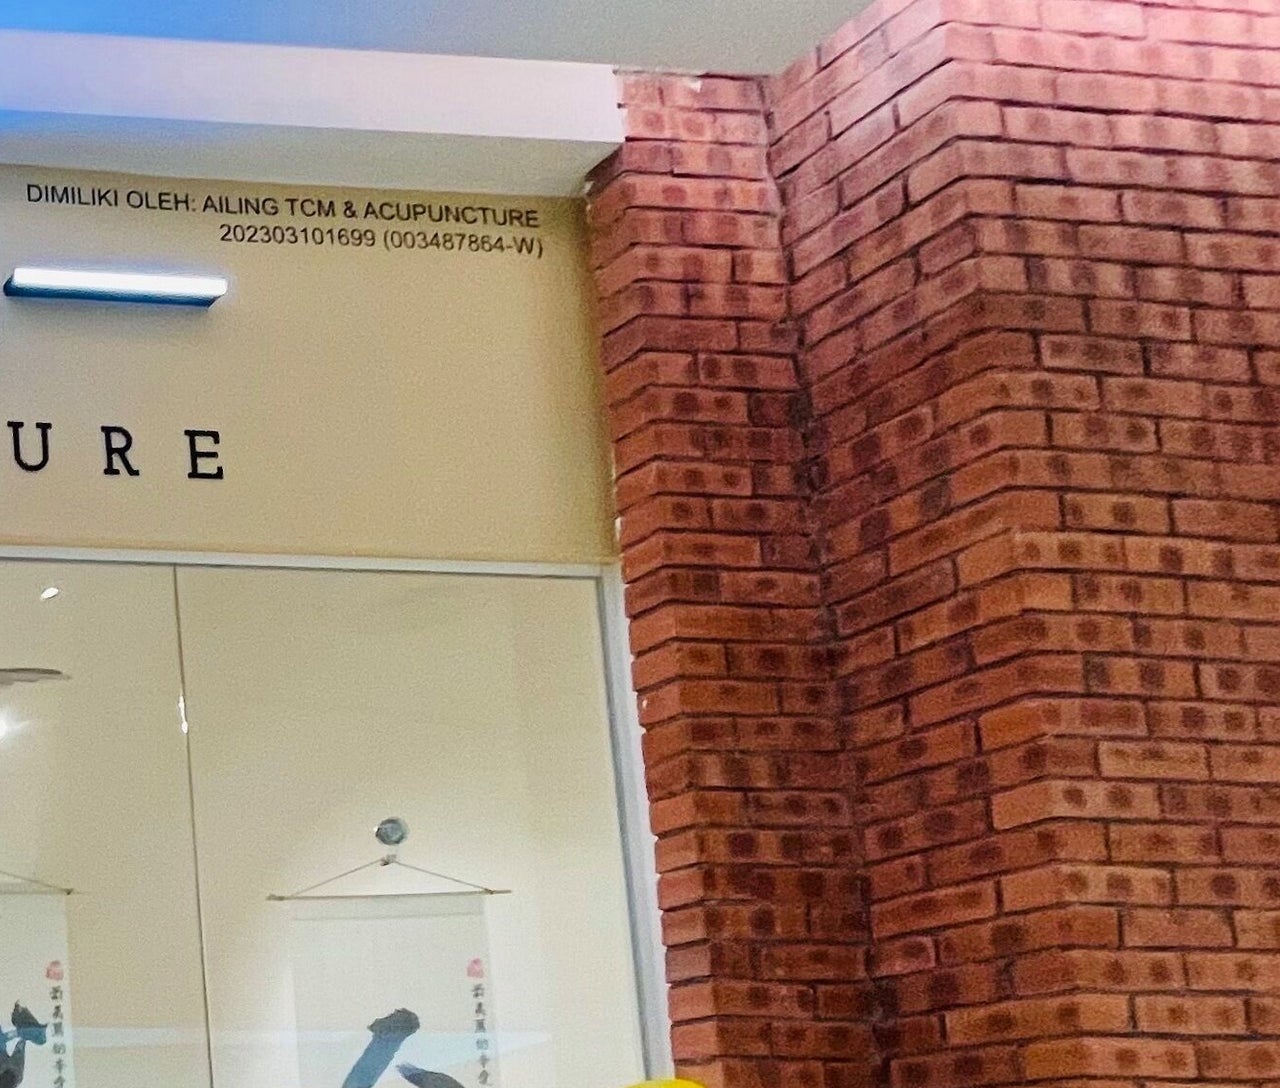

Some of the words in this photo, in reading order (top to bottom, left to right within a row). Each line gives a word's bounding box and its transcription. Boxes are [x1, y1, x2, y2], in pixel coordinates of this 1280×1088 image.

[26, 184, 118, 208] DIMILIKI
[127, 190, 196, 212] OLEH:
[202, 196, 279, 217] AILING
[285, 198, 336, 218] TCM
[344, 200, 358, 219] &
[363, 201, 540, 229] ACUPUNCTURE
[219, 224, 376, 248] 202303101699
[383, 229, 544, 259] (003487864-W)
